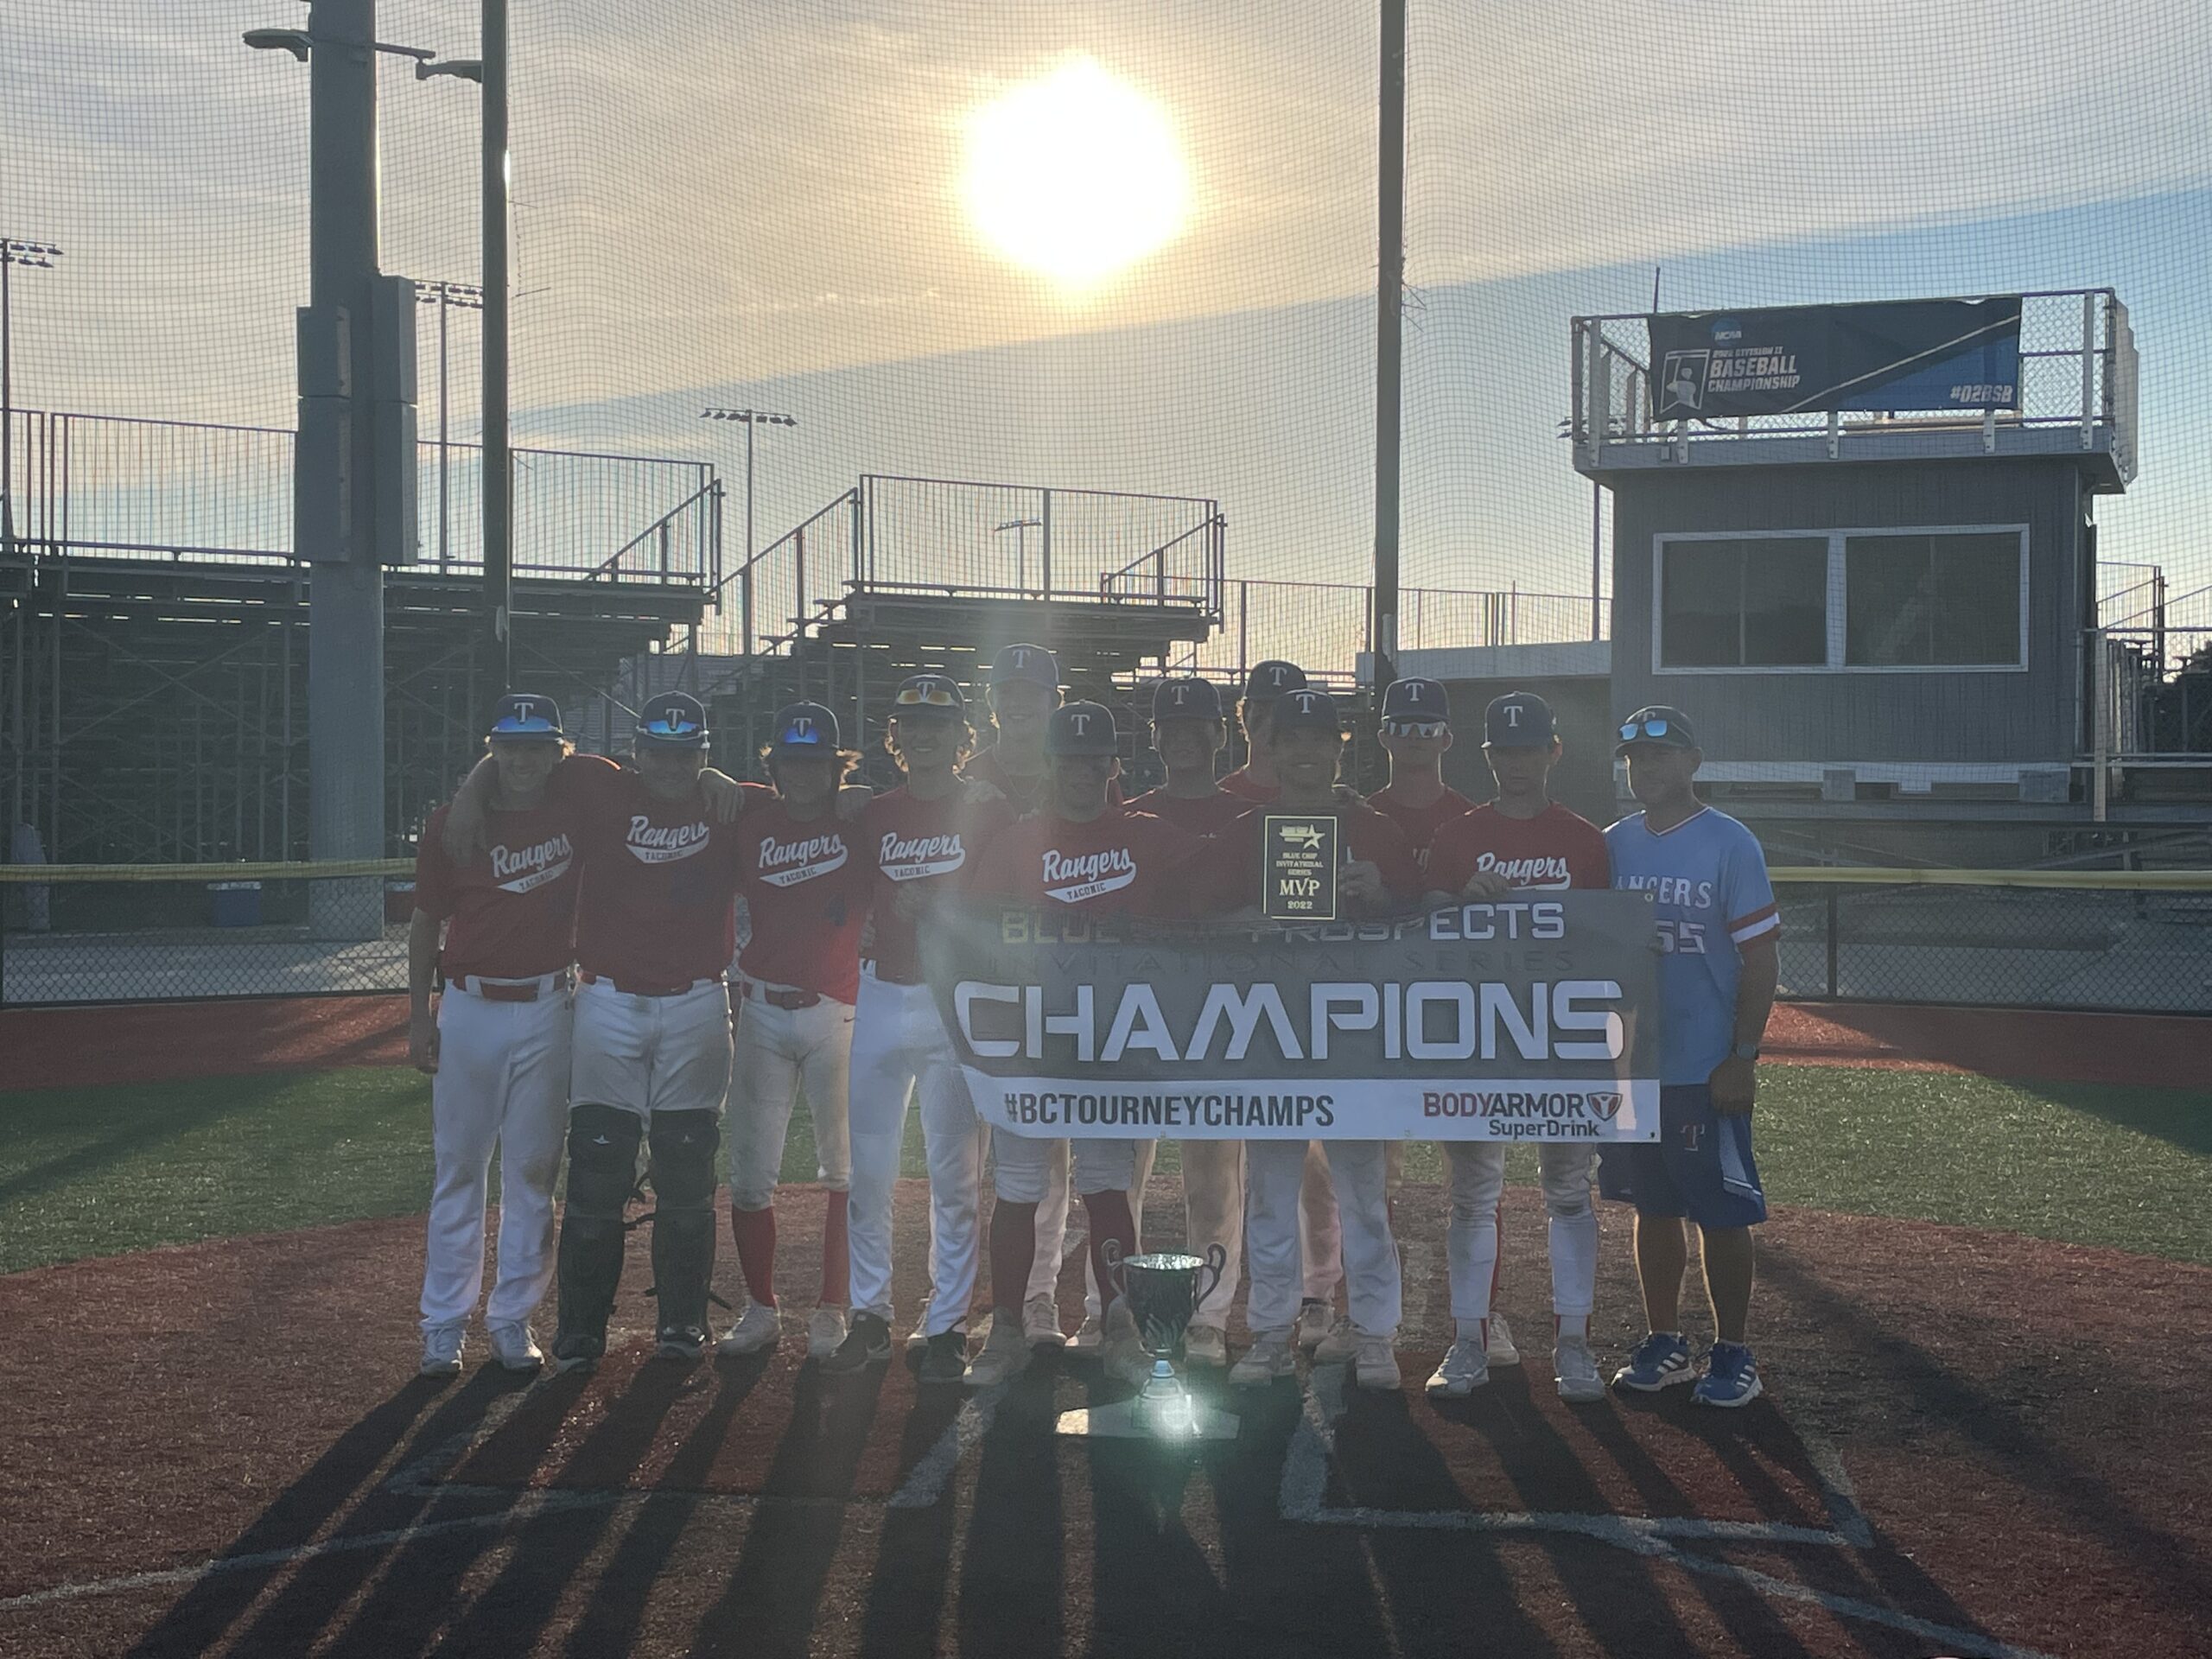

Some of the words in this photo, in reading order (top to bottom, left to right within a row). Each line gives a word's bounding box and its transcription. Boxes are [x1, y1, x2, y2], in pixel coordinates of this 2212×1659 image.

[1710, 355, 1796, 378] BASEBALL
[1708, 375, 1800, 392] CHAMPIONSHIP
[1950, 385, 2013, 403] #D2BSB
[1012, 650, 1031, 668] T
[1269, 666, 1287, 686] T
[1171, 685, 1190, 705] T
[1405, 683, 1424, 702] T
[514, 702, 534, 723] T
[1297, 693, 1316, 714] T
[665, 708, 686, 729] T
[1071, 714, 1090, 736] T
[1503, 705, 1522, 727] T
[792, 716, 812, 738] T
[627, 815, 709, 850] Rangers
[490, 834, 571, 878] Rangers
[759, 834, 842, 869] Rangers
[880, 831, 961, 864] Rangers
[779, 866, 817, 885] TACONIC
[893, 865, 931, 878] TACONIC
[1042, 848, 1130, 883] Rangers
[1066, 882, 1107, 900] TACONIC
[1280, 877, 1320, 896] MVP
[1287, 900, 1313, 910] 2022
[954, 980, 1624, 1062] CHAMPIONS
[1004, 1092, 1334, 1127] #BCTOURNEYCHAMPS
[1423, 1091, 1586, 1118] BODYARMOR
[1489, 1120, 1600, 1140] SuperDrink
[1681, 1124, 1705, 1152] T
